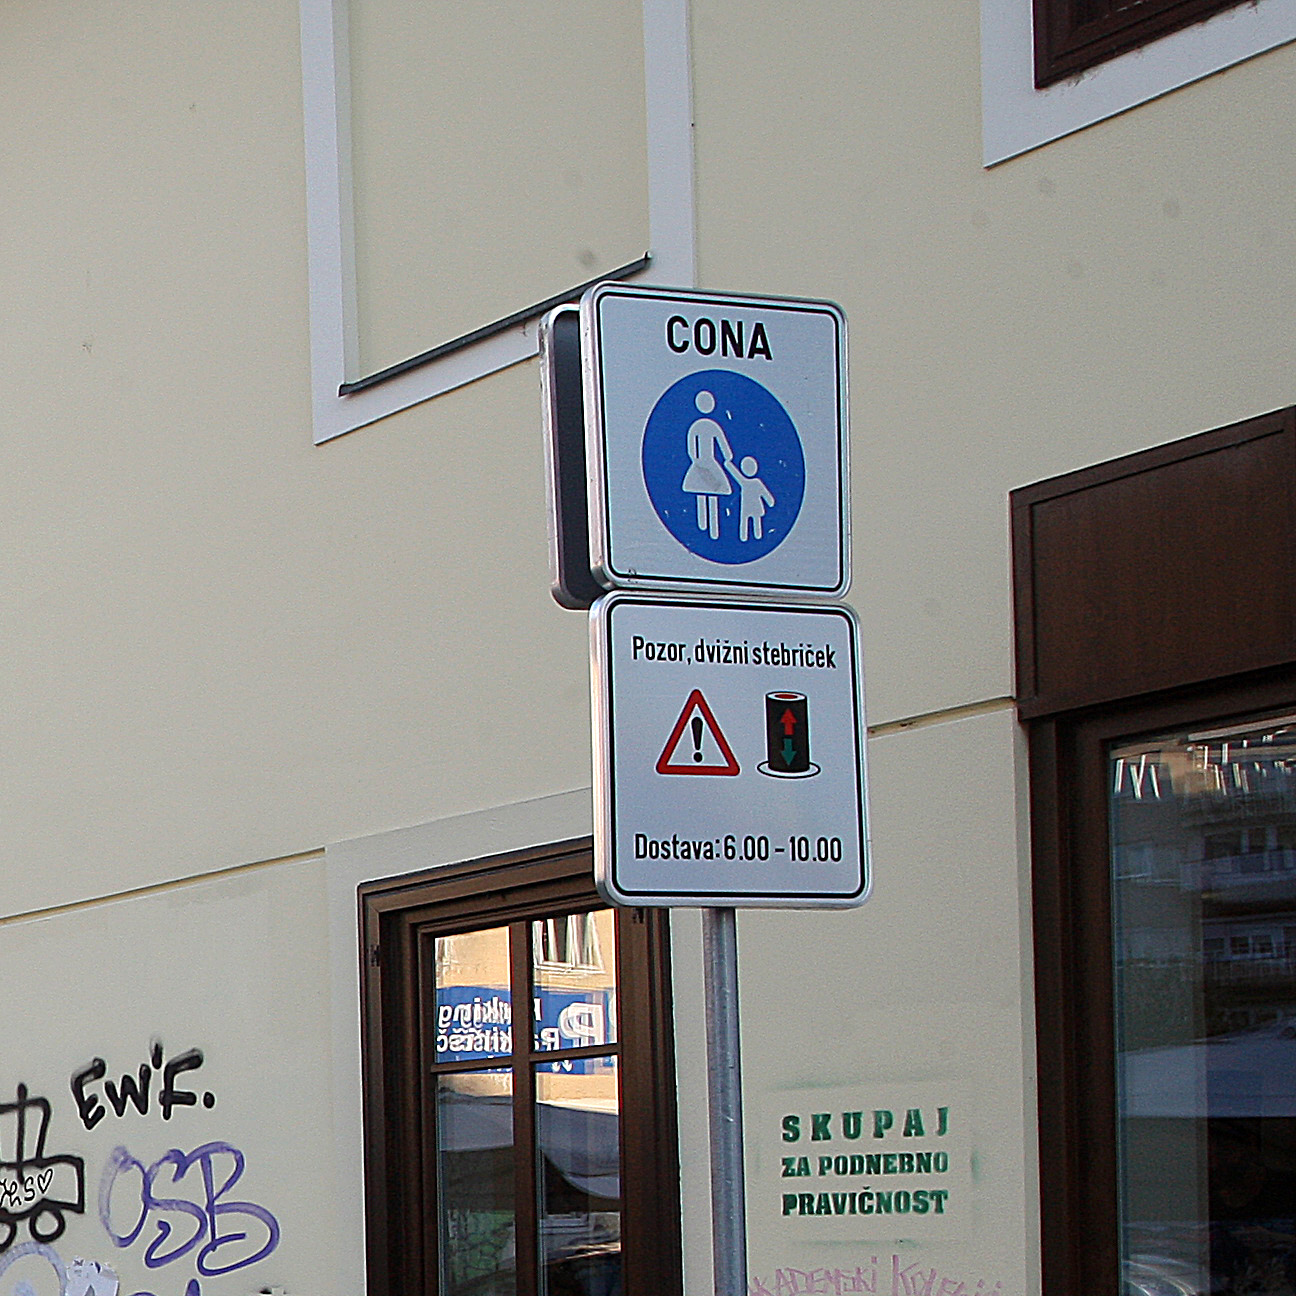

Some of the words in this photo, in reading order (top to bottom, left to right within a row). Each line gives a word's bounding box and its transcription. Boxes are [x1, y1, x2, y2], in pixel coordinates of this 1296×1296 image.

[666, 314, 773, 361] CONA
[632, 635, 692, 667] Pozor,
[694, 637, 749, 666] dvižni
[751, 641, 836, 670] stebriček
[788, 836, 842, 862] 10.00
[782, 1107, 949, 1143] SKUPAJ
[782, 1157, 811, 1178] ZA
[817, 1151, 949, 1177] PODNEBNO
[782, 1185, 949, 1216] PRAVIČNOST
